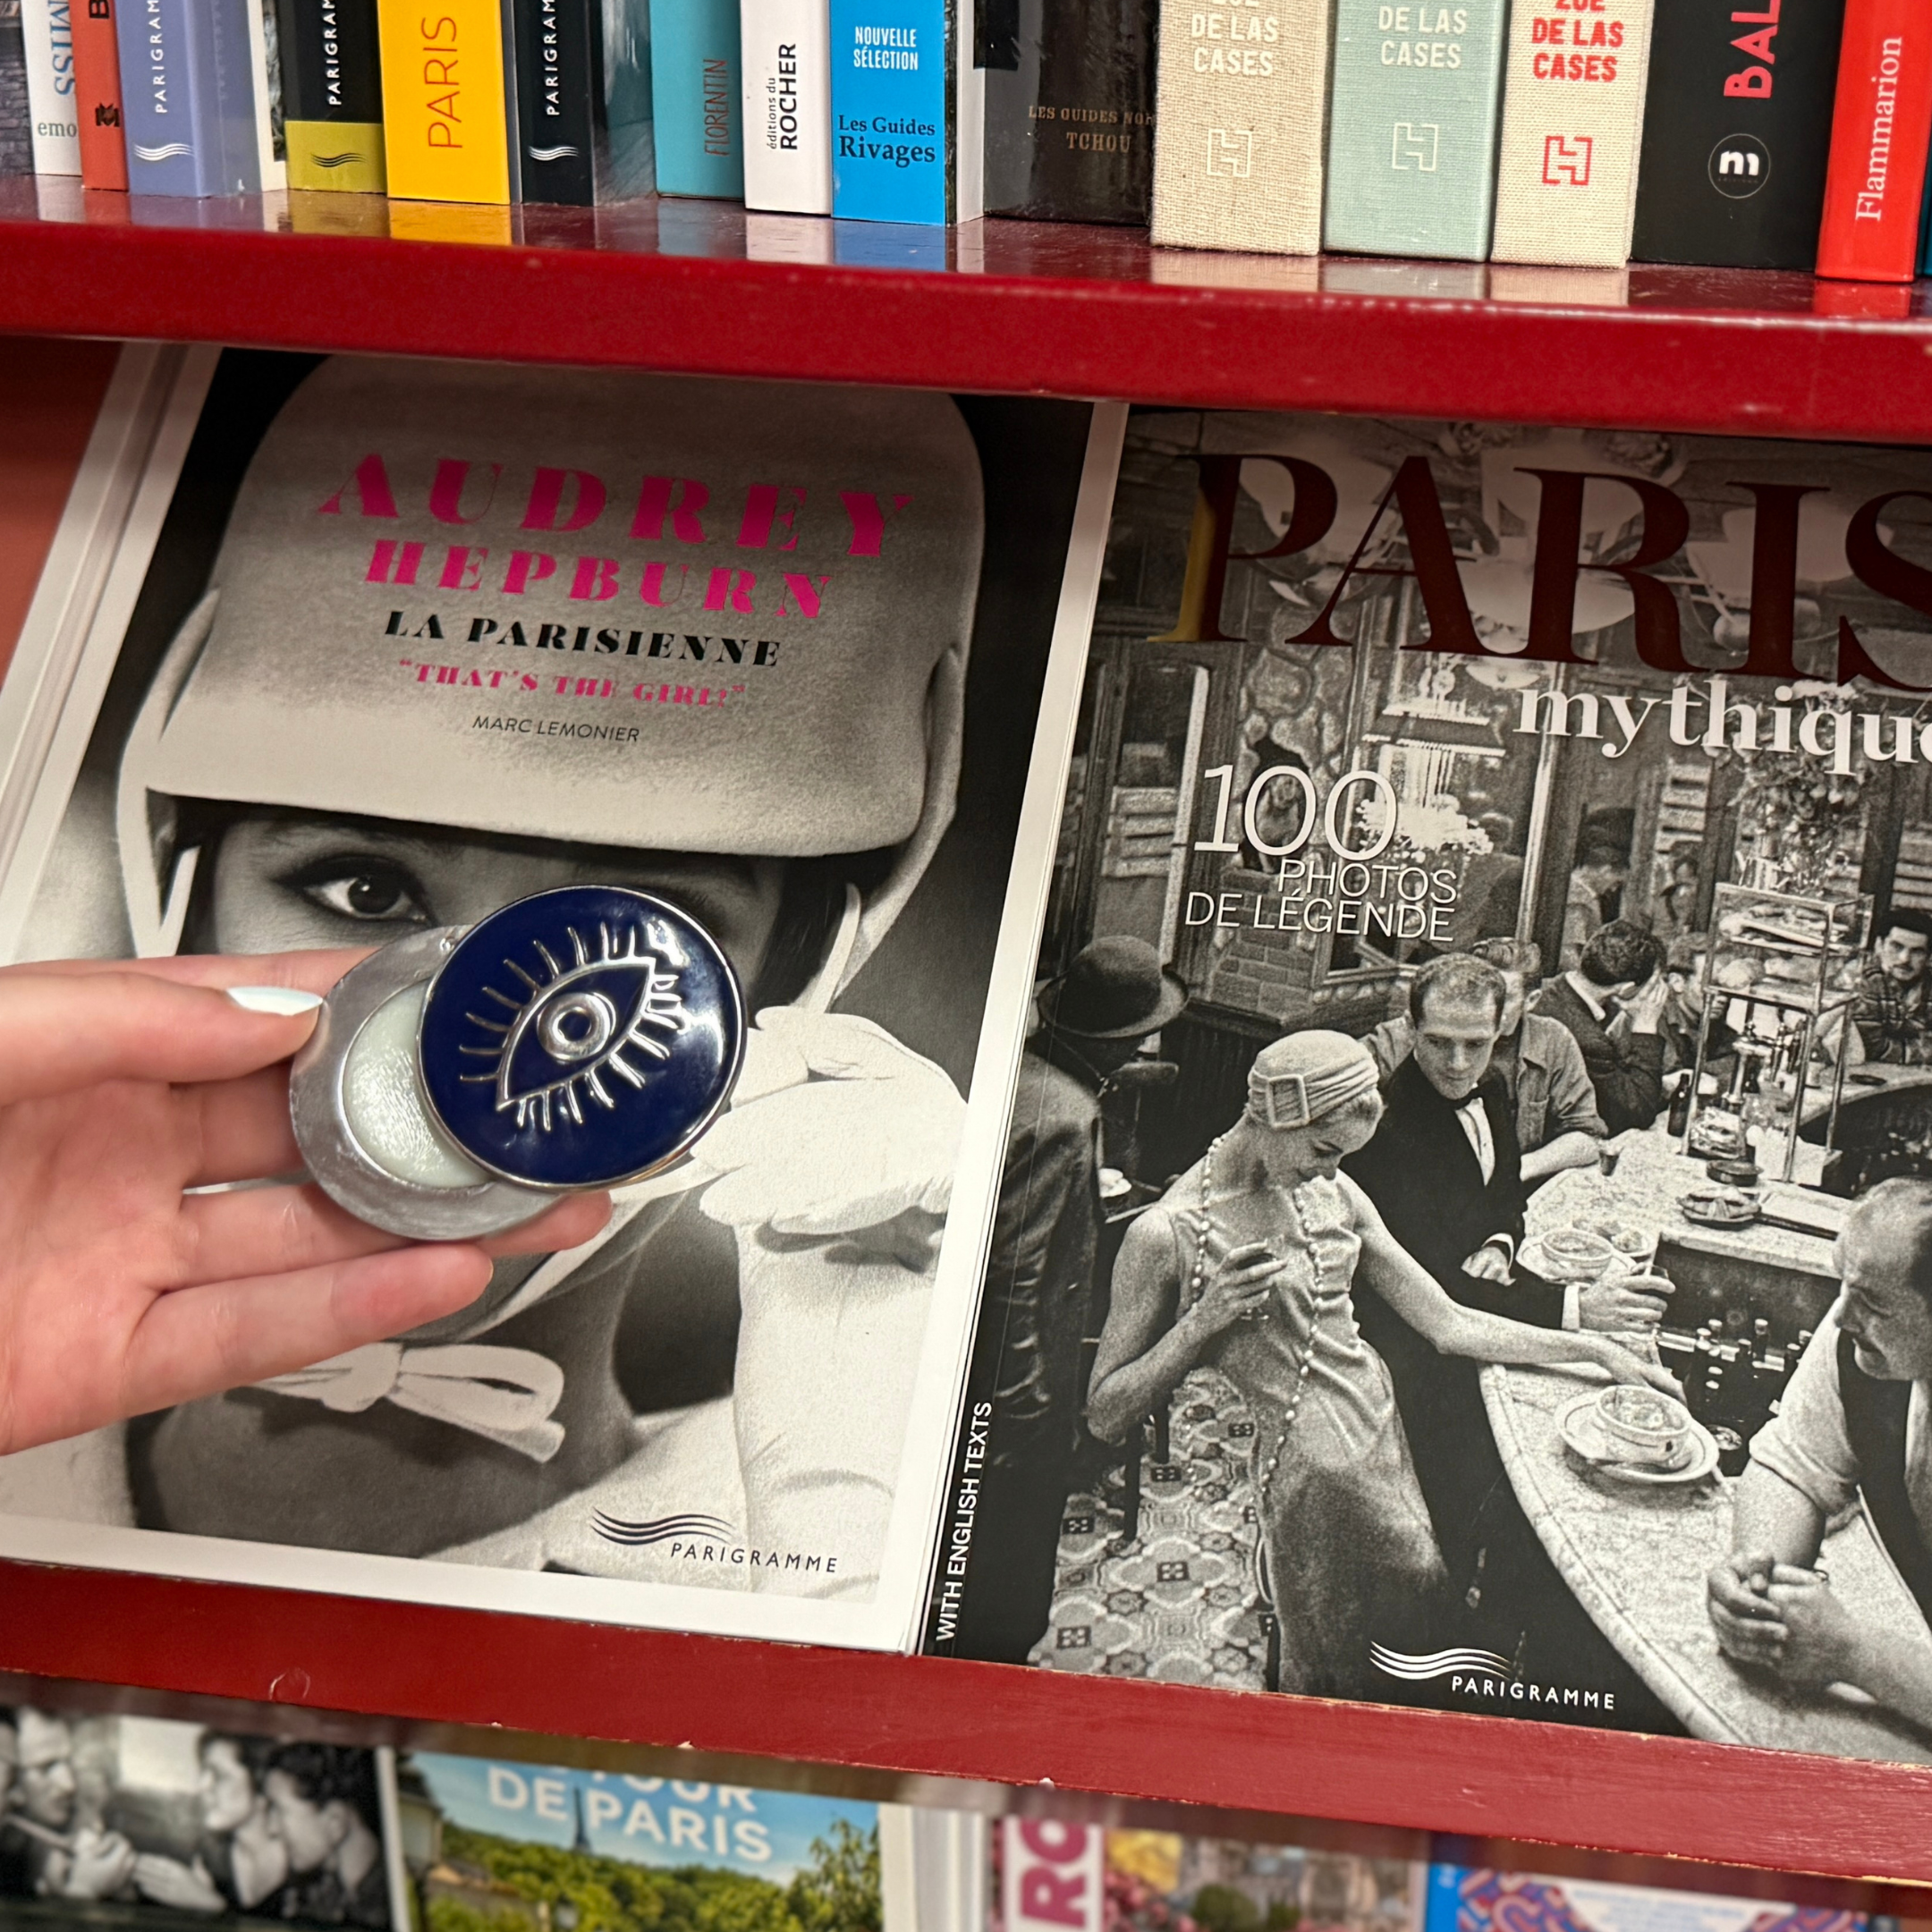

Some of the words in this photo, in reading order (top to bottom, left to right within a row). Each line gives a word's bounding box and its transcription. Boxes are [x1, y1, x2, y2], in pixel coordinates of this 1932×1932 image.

[854, 26, 917, 47] NOUVELLE
[1191, 13, 1223, 39] DE
[1230, 15, 1279, 43] LAS
[1378, 5, 1411, 32] DE
[1419, 7, 1468, 35] LAS
[1531, 17, 1566, 45] DE
[1572, 19, 1624, 47] LAS
[852, 47, 919, 71] SÉLECTION
[1193, 47, 1274, 77] CASES
[1381, 39, 1462, 70] CASES
[1532, 52, 1618, 82] CASES
[421, 17, 462, 148] PARIS
[766, 77, 776, 94] du
[778, 43, 798, 150] ROCHER
[703, 58, 730, 157] FLORENTIN
[766, 97, 777, 149] éditions
[838, 114, 868, 131] Les
[872, 116, 936, 136] Guides
[1029, 106, 1056, 120] LES
[1061, 107, 1117, 124] GUIDES
[1066, 131, 1131, 153] TCHOU
[1855, 36, 1902, 222] Flammarion
[838, 135, 936, 168] Rivages
[318, 453, 914, 556] AUDREY
[364, 539, 832, 618] HEPBURN
[1148, 453, 1932, 691] PARIS
[385, 611, 445, 640] LA
[467, 618, 781, 666] PARISIENNE
[553, 675, 618, 698] THE
[471, 716, 532, 733] MARC
[537, 721, 640, 742] LEMONIER
[1194, 764, 1397, 860] 100
[1277, 859, 1457, 904] PHOTOS
[1185, 892, 1242, 927] DE
[1253, 888, 1455, 942] LÉGENDE
[963, 1402, 992, 1474] TEXTS
[946, 1478, 980, 1576] ENGLISH
[671, 1542, 838, 1572] PARIGRAMME
[936, 1580, 963, 1641] WITH
[1452, 1675, 1614, 1710] PARIGRAMME
[488, 1766, 569, 1821] DE
[586, 1788, 772, 1862] PARIS
